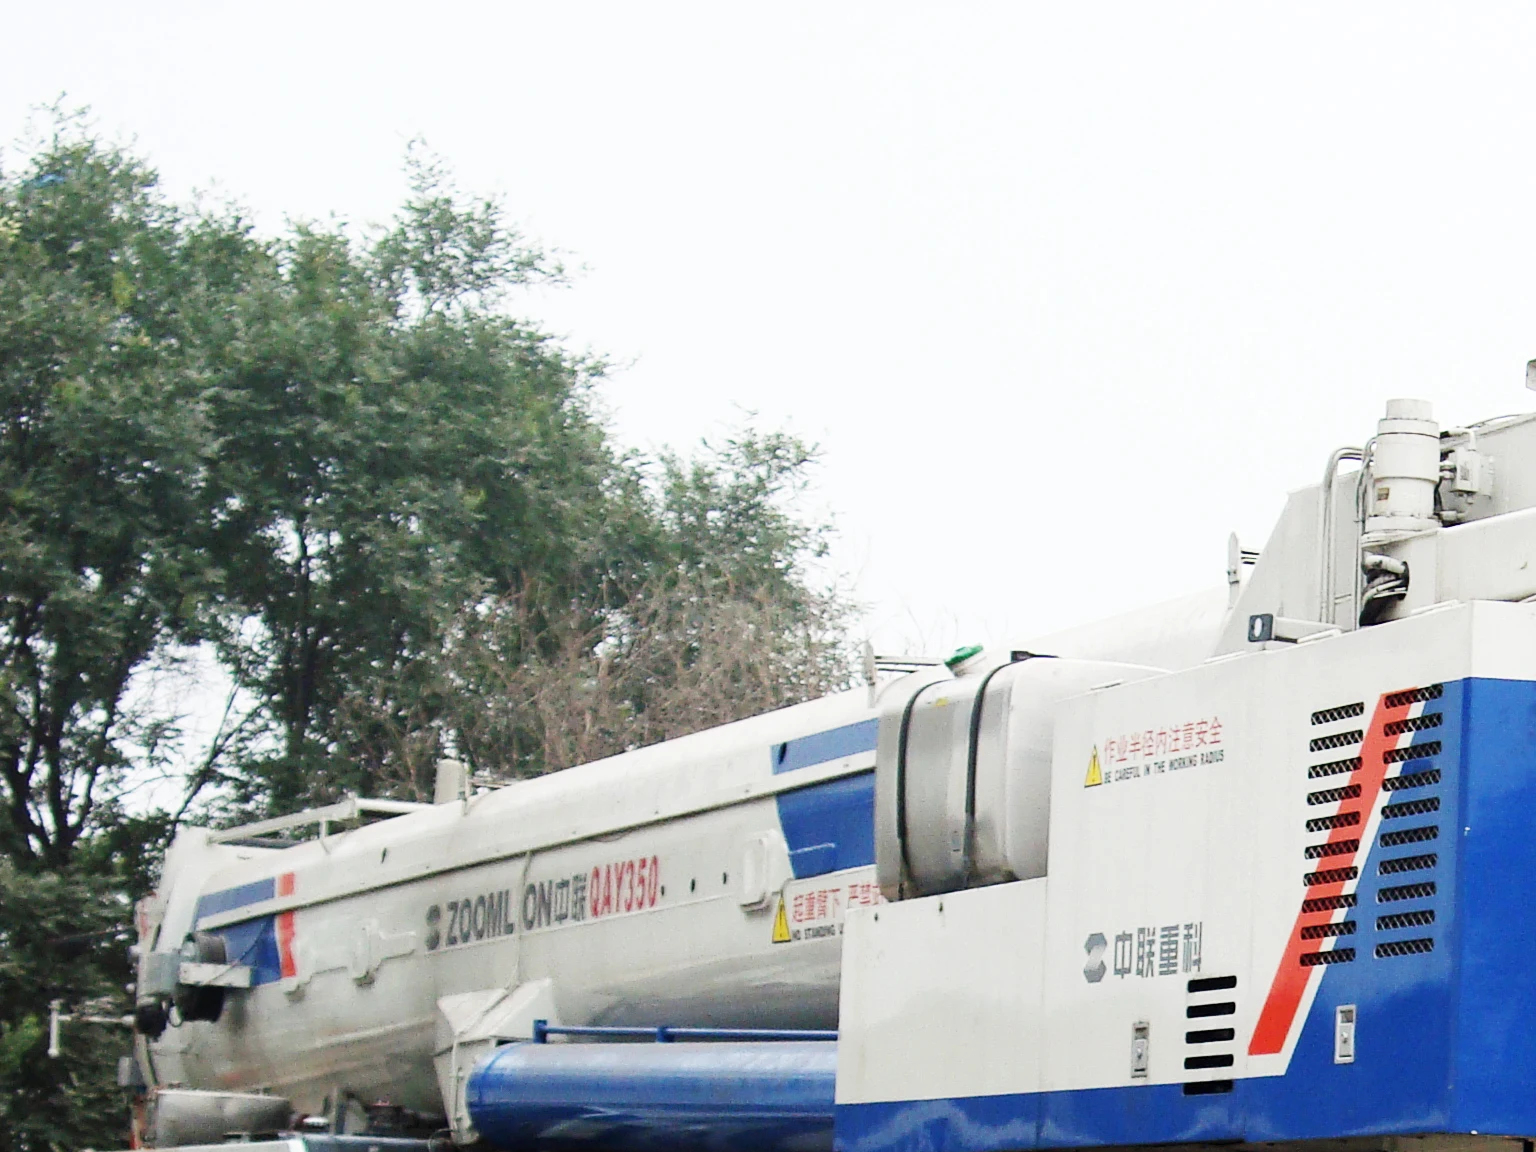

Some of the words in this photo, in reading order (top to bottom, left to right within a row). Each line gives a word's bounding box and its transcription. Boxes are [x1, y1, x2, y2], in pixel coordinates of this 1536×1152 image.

[1104, 716, 1223, 765] 作业半径内注意安全
[1104, 771, 1112, 784] BE
[1115, 766, 1141, 782] CAREFUL
[1144, 763, 1151, 776] IN
[1154, 760, 1165, 774] THE
[1168, 754, 1198, 771] WORKING
[1200, 749, 1224, 765] RADIUS
[446, 880, 553, 946] ZOOMLON
[590, 855, 659, 918] QAY350
[1113, 921, 1203, 979] 中联重科
